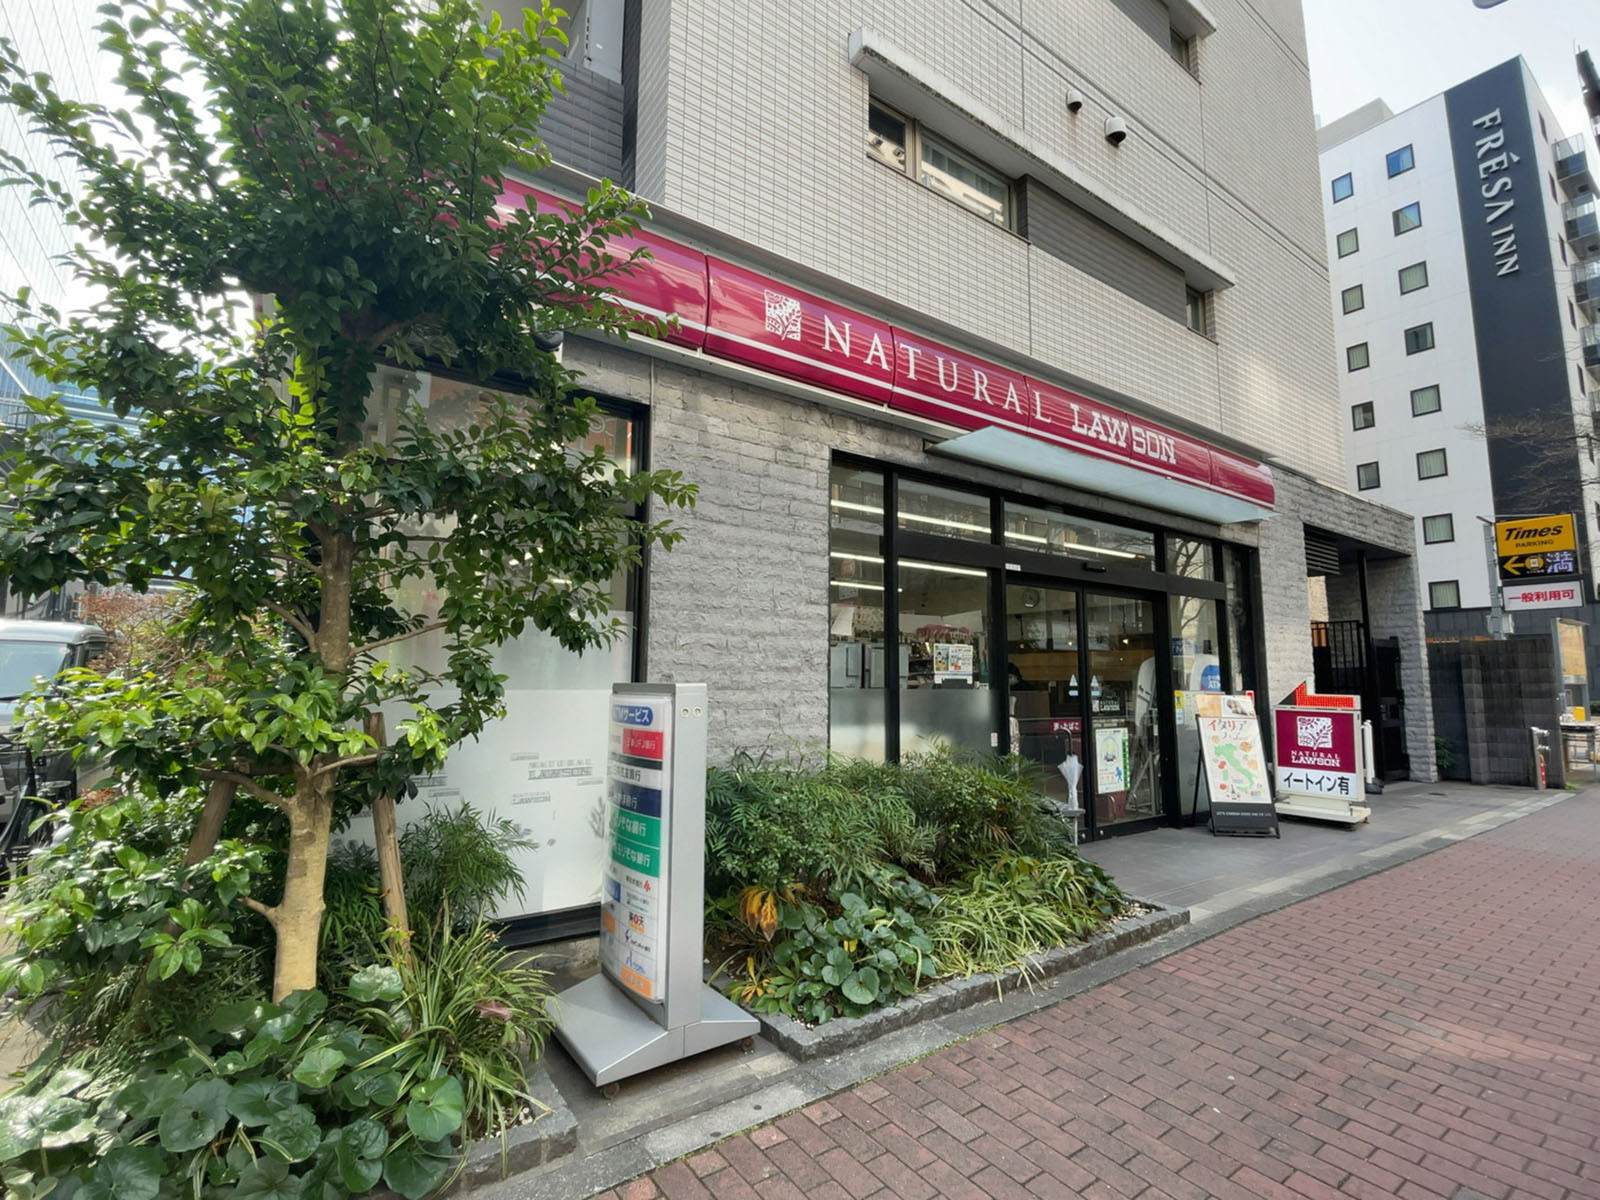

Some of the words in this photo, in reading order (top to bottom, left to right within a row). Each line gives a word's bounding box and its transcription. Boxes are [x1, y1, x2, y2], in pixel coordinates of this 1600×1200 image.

[1491, 223, 1520, 277] INN
[822, 314, 1052, 424] NATURAL
[1070, 402, 1177, 465] LAWSON
[1505, 525, 1564, 542] Times
[1515, 539, 1554, 548] PARKING
[1508, 589, 1575, 603] 一般利用可
[1291, 750, 1340, 760] NATURAL
[1291, 755, 1341, 768] LAWSON
[1283, 772, 1350, 795] イートイン有
